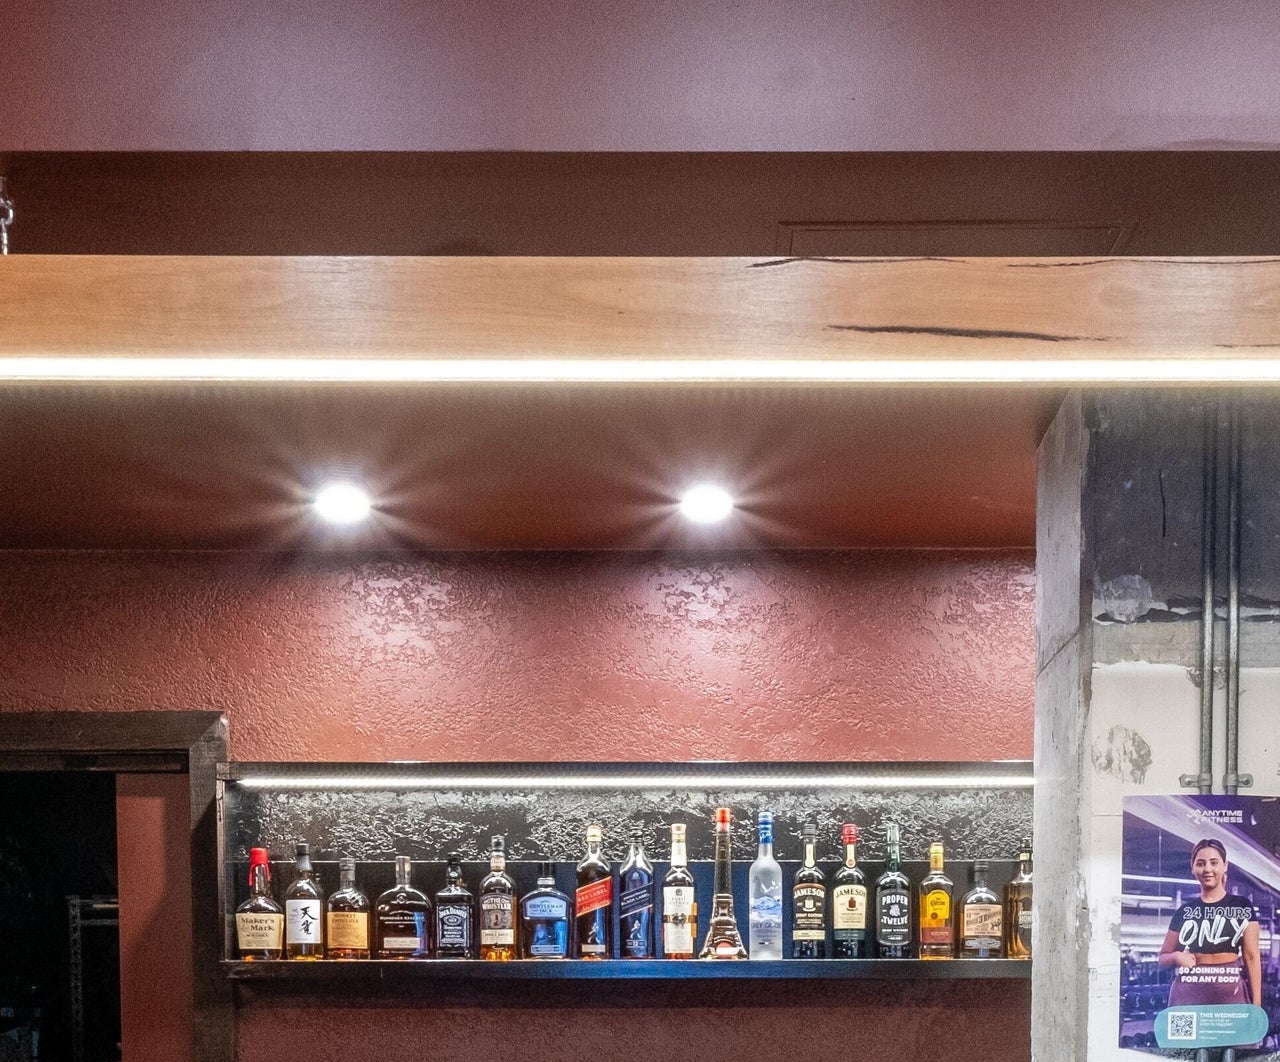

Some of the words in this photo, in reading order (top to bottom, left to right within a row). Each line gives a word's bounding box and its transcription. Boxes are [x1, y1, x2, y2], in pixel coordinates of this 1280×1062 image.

[794, 888, 825, 899] JAMESON
[836, 889, 866, 898] JAMESON
[882, 895, 908, 906] PROPER
[1183, 907, 1201, 919] 24
[1204, 907, 1252, 919] HOURS
[884, 915, 908, 925] TWELVE
[1179, 914, 1249, 947] ONLY
[1179, 967, 1190, 975] $0
